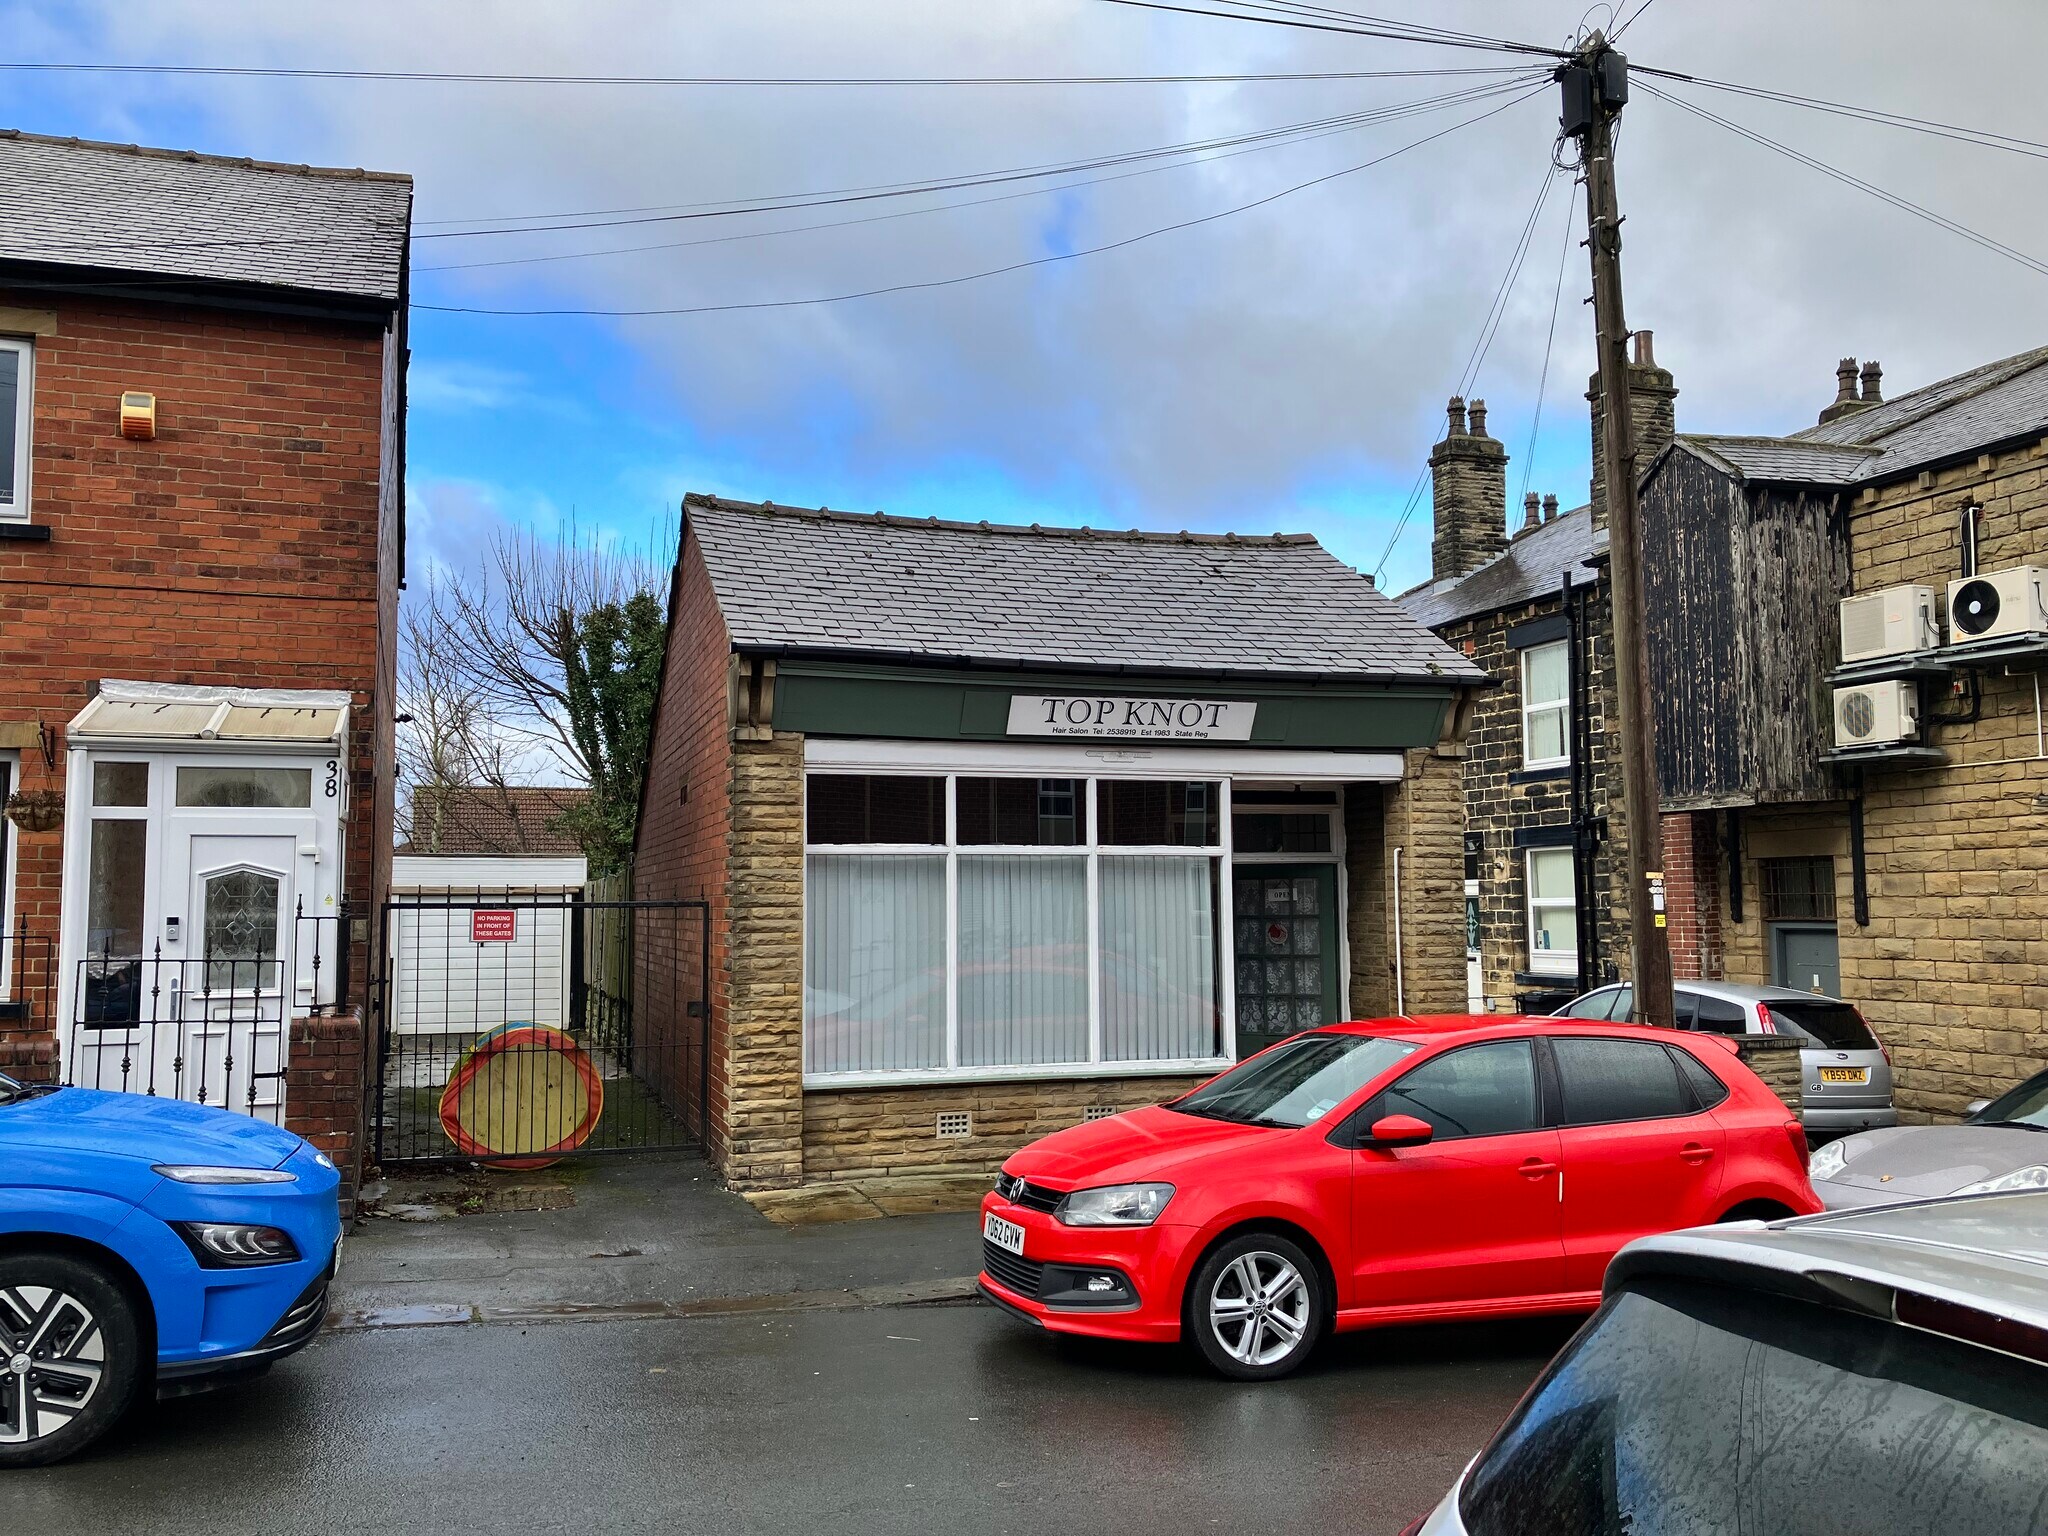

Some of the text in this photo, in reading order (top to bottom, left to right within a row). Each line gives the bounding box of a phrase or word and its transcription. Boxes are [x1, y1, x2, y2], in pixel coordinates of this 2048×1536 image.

[1041, 698, 1228, 728] TOP KNOT
[1093, 727, 1105, 735] Tel:
[1106, 728, 1137, 736] 2538919
[1194, 730, 1209, 738] Reg
[325, 760, 338, 798] 38
[1824, 1070, 1847, 1080] YB59
